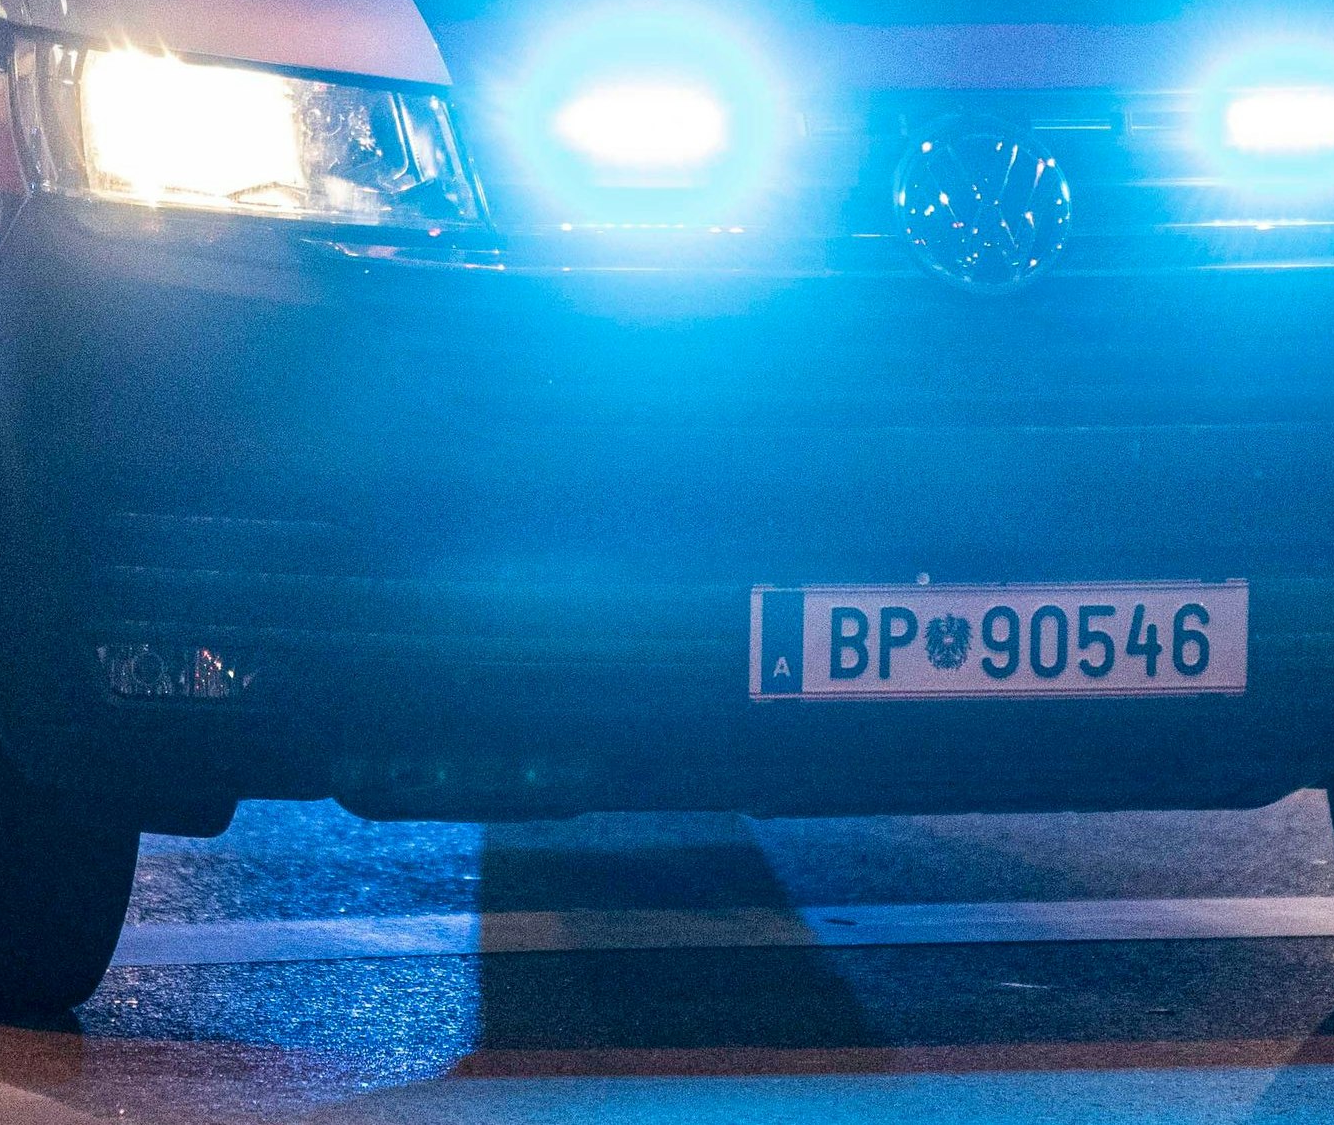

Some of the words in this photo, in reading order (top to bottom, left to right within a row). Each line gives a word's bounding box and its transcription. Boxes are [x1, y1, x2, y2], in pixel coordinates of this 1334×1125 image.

[772, 656, 793, 677] A
[829, 606, 919, 681] BP
[981, 602, 1211, 679] 90546
